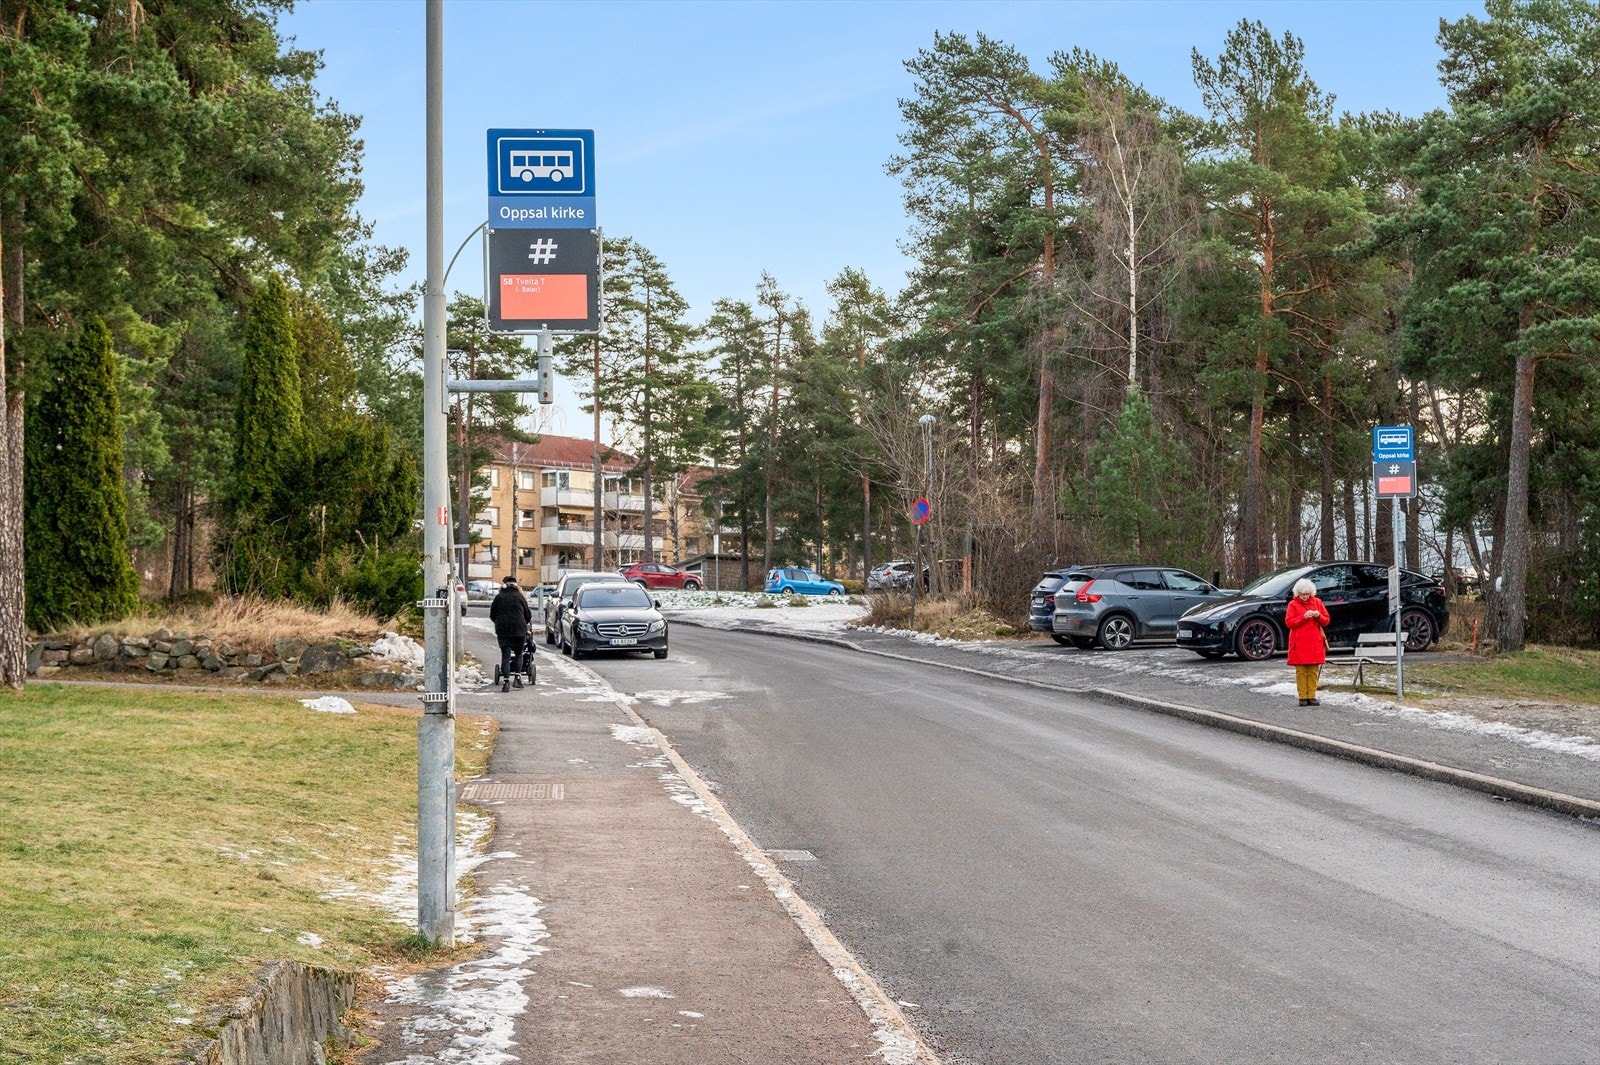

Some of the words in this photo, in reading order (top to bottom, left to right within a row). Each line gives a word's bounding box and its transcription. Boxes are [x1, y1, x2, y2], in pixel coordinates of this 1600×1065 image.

[500, 206, 547, 221] Oppsal
[552, 206, 585, 219] kirke
[515, 277, 539, 285] Tveita
[541, 277, 545, 285] T
